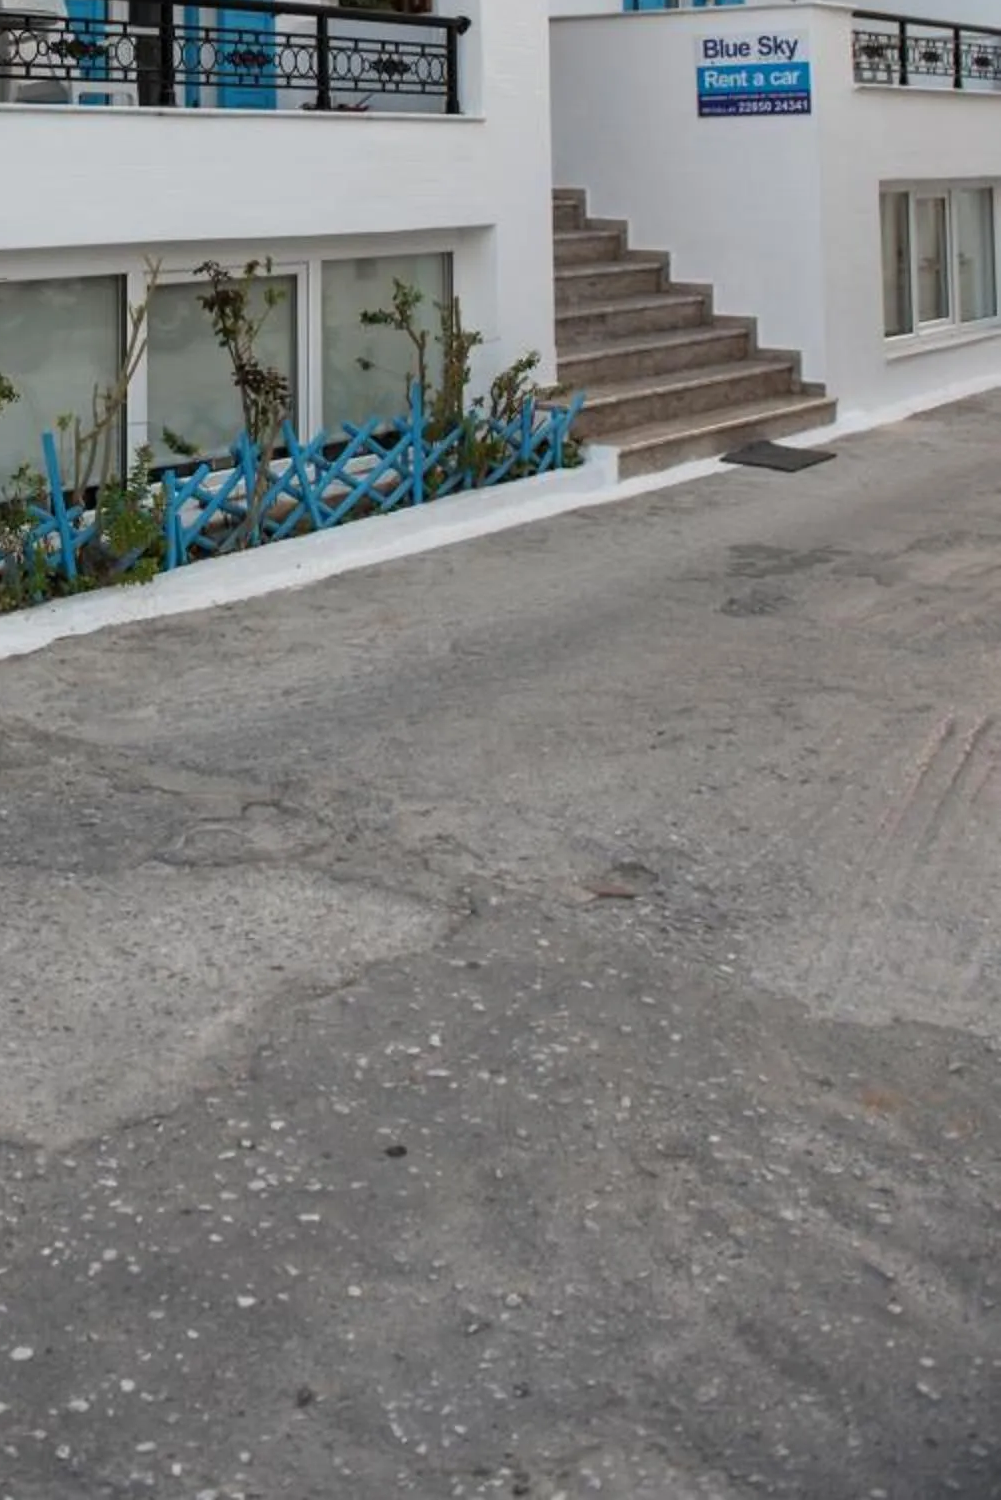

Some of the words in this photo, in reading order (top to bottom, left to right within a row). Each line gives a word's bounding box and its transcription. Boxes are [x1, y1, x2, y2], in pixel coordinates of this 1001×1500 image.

[702, 38, 751, 59] Blue
[757, 35, 799, 61] Sky
[703, 70, 748, 88] Rent
[752, 74, 765, 87] a
[770, 69, 801, 85] car
